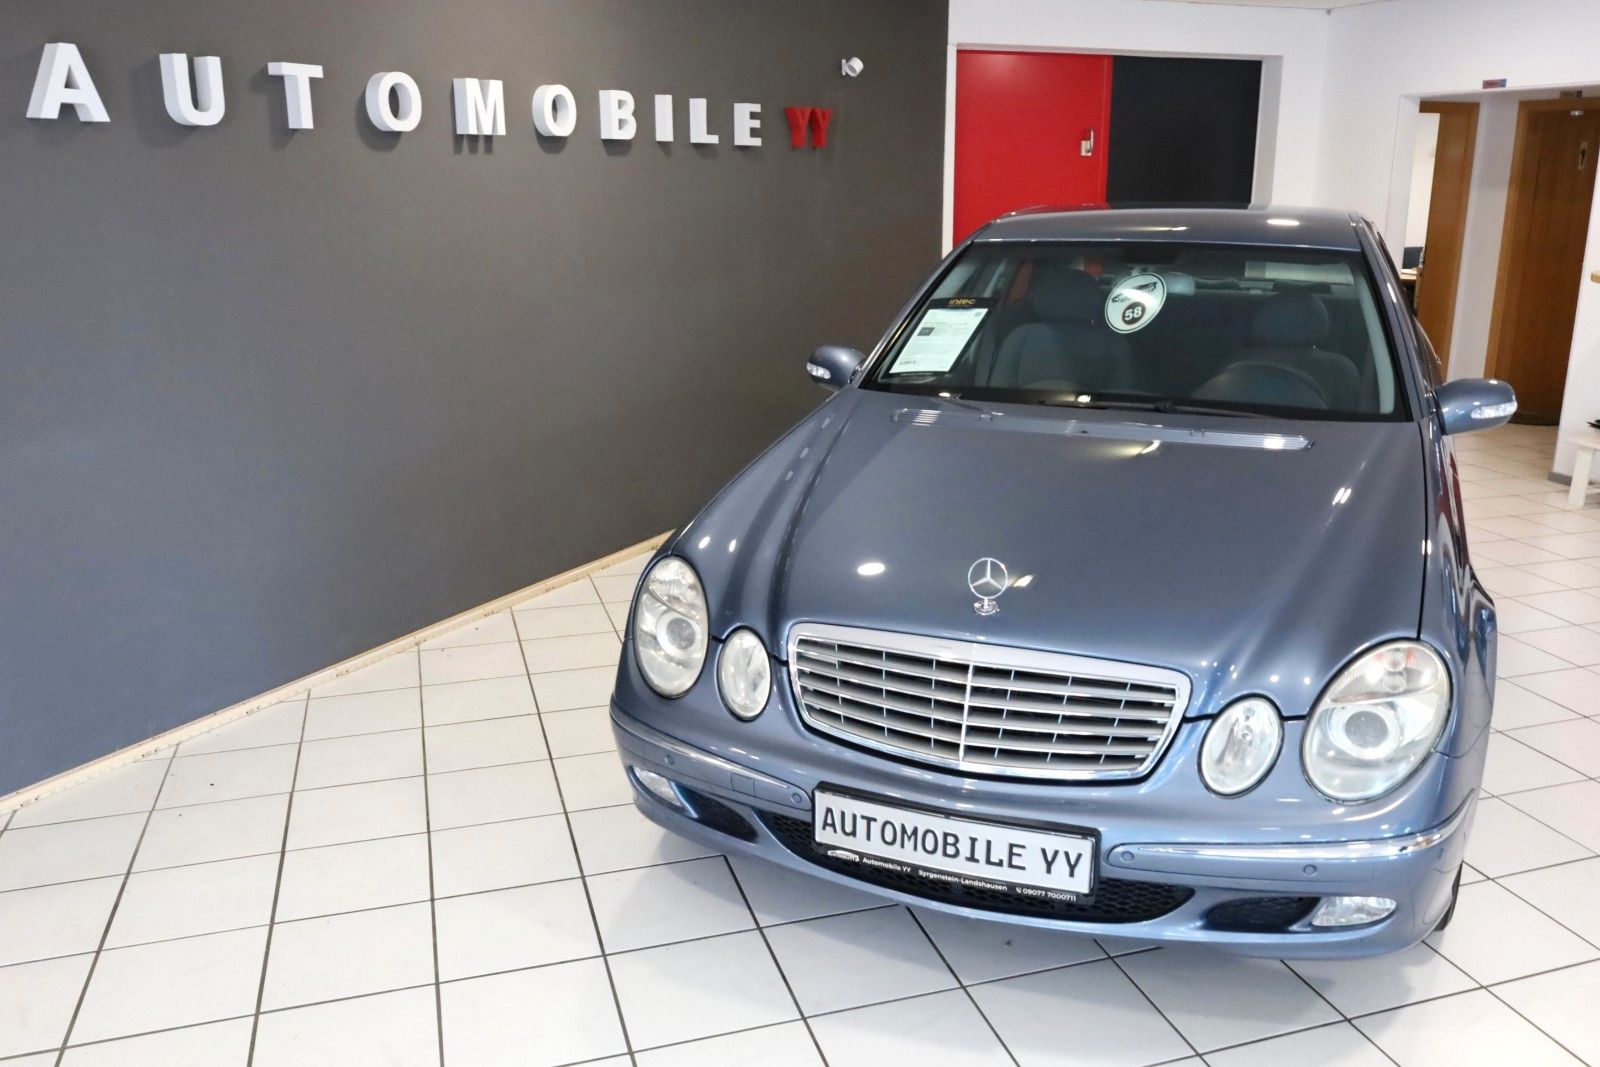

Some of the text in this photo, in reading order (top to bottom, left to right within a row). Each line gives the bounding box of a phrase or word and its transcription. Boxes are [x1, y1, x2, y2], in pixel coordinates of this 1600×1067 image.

[26, 42, 833, 148] AUTOMOBILE YY
[1125, 306, 1142, 320] 58
[822, 806, 1083, 878] AUTOMOBILE YY
[863, 857, 901, 871] Automobile
[902, 865, 912, 873] YY
[918, 869, 1008, 891] Syrgenstein-Landshausen
[1022, 887, 1046, 898] 09077
[1047, 891, 1077, 902] 7000711
